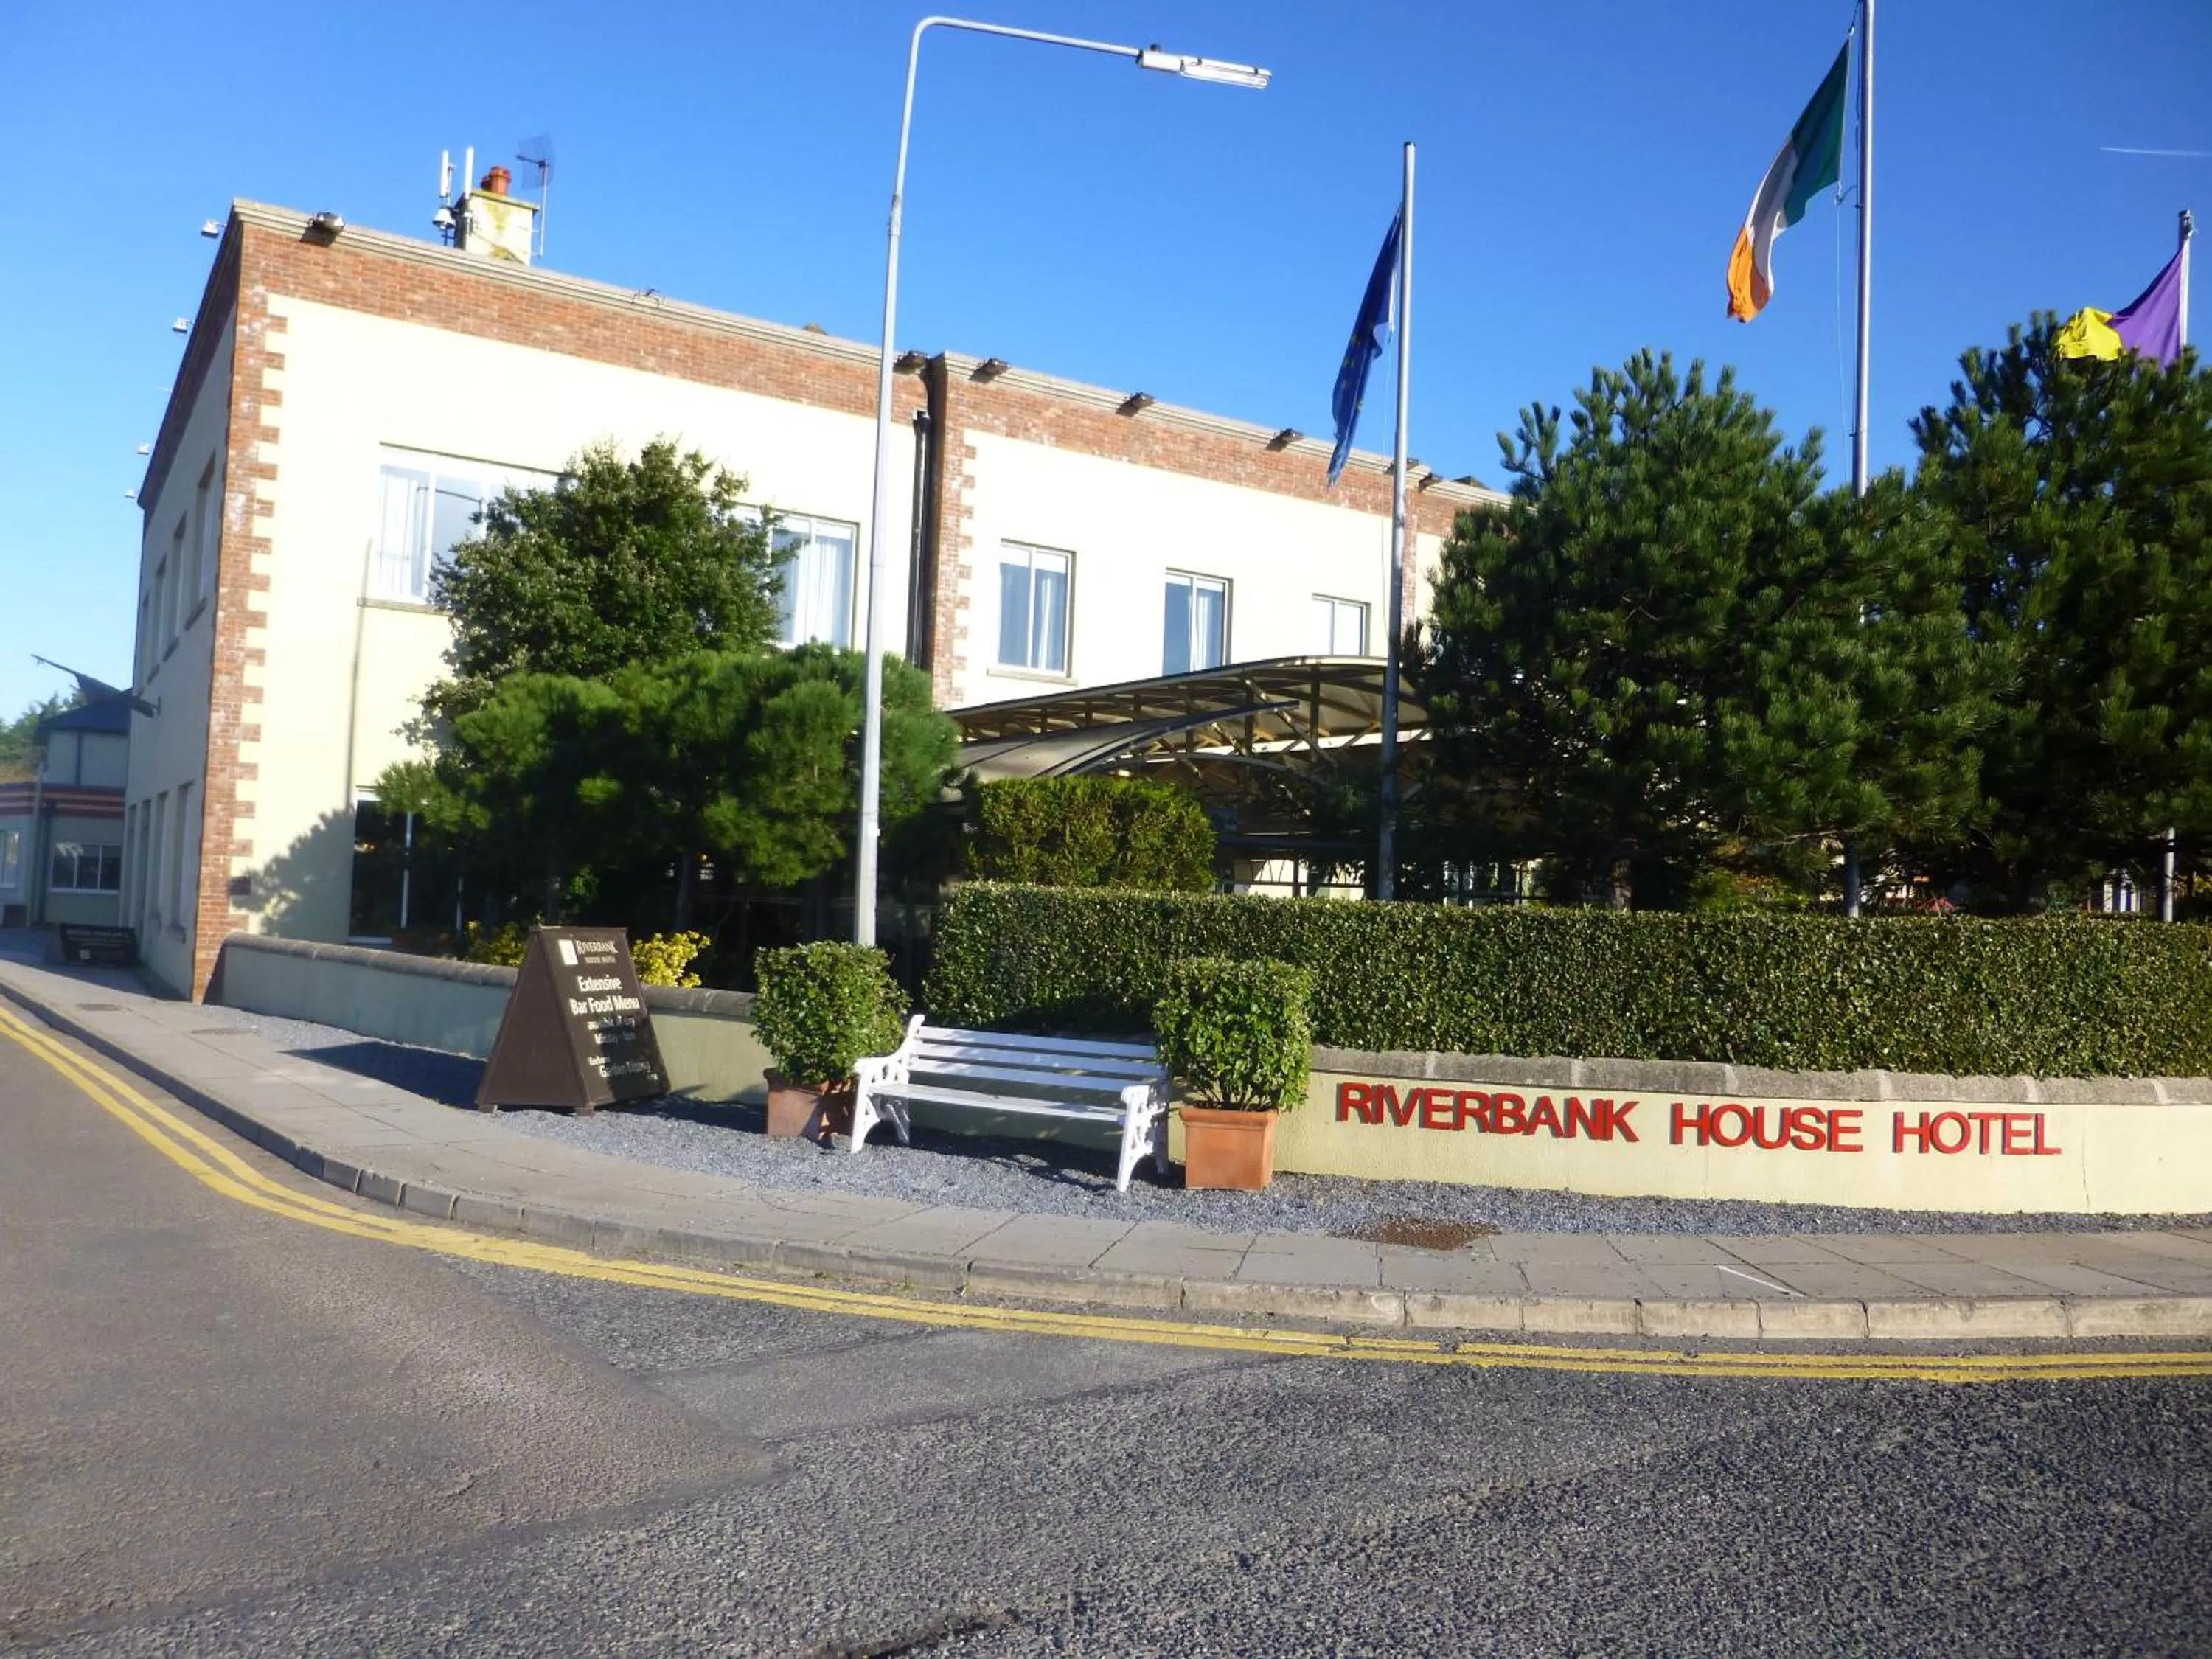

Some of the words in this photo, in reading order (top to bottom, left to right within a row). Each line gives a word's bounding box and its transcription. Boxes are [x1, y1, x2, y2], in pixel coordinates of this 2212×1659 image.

[577, 975, 623, 992] Extensive
[569, 998, 588, 1015] Bar
[588, 995, 613, 1013] Food
[613, 995, 640, 1011] Menu
[1336, 1082, 1640, 1143] RIVERBANK
[1670, 1103, 1863, 1152] HOUSE
[1892, 1111, 2062, 1155] HOTEL
